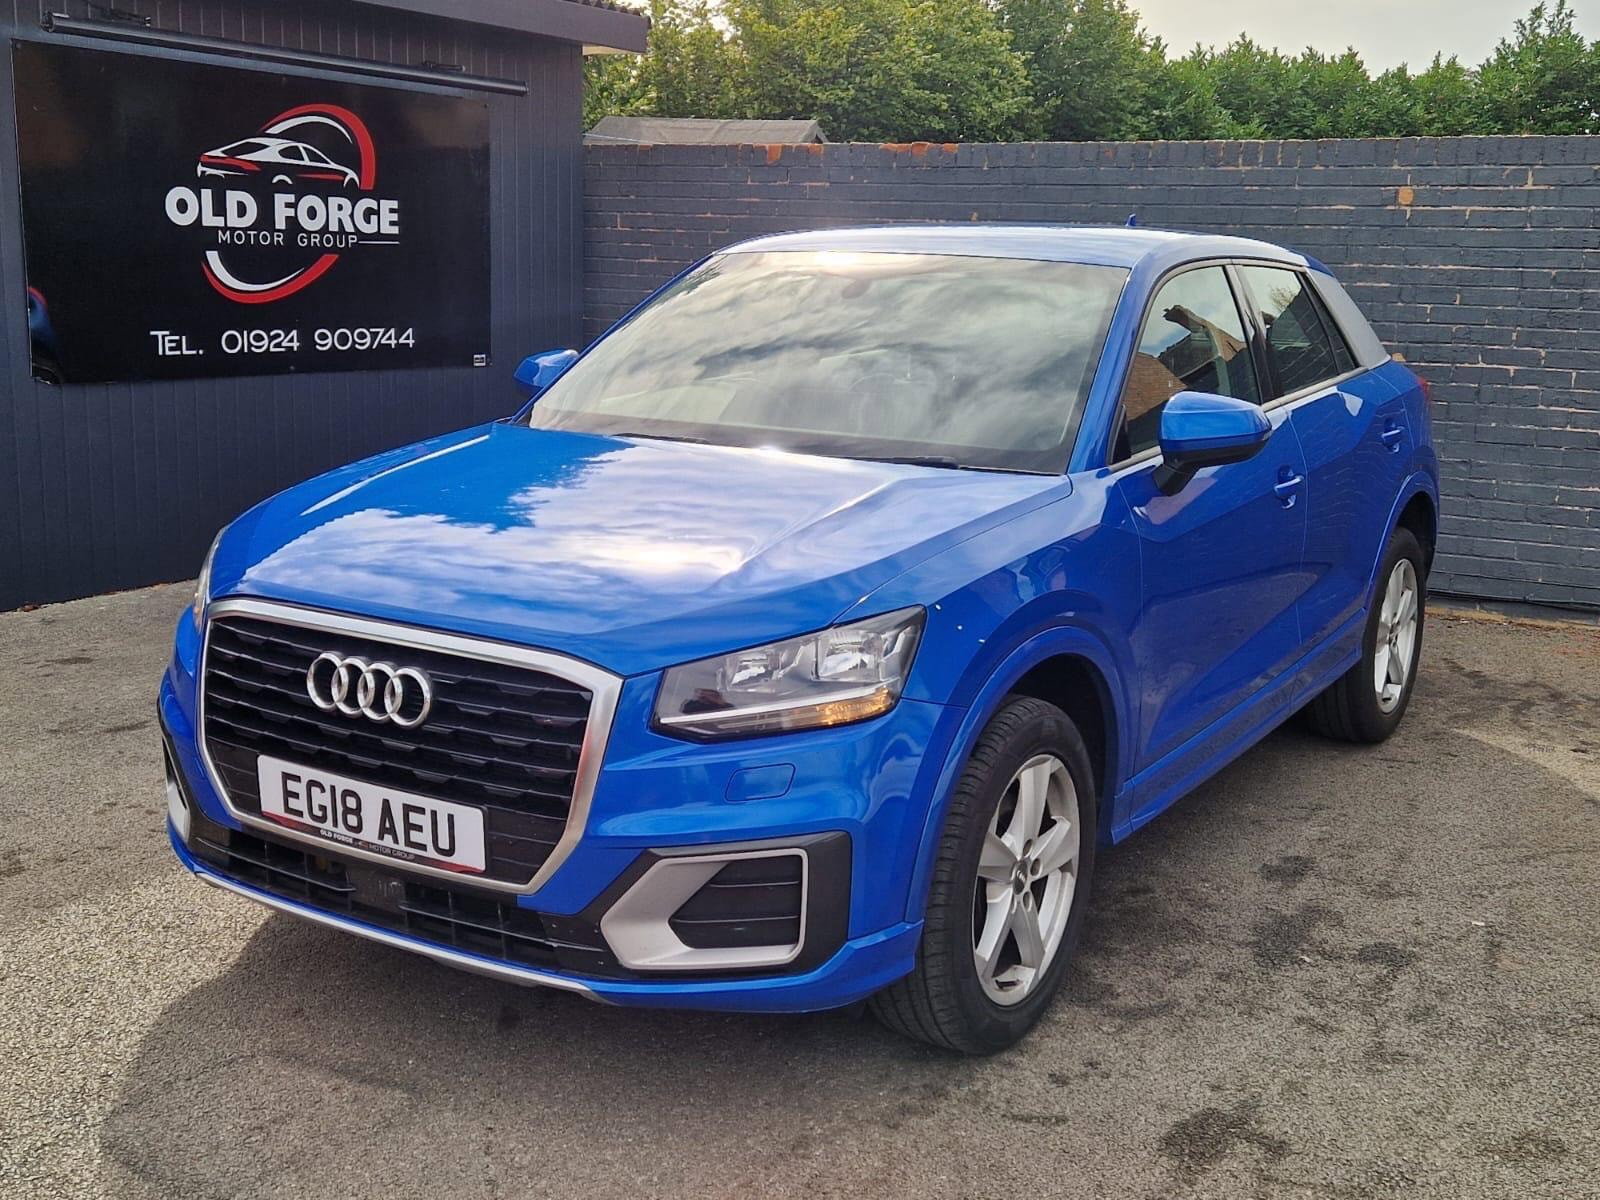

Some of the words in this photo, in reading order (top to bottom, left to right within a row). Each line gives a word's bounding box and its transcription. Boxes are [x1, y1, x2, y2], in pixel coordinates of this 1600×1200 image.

[165, 186, 258, 228] OLD
[274, 193, 399, 234] FORGE
[218, 230, 284, 246] MOTOR
[297, 233, 358, 247] GROUP
[221, 329, 300, 354] 01924
[313, 328, 415, 351] 909744
[281, 771, 364, 835] EG18
[378, 798, 456, 858] AEU
[368, 843, 391, 854] MOTOR
